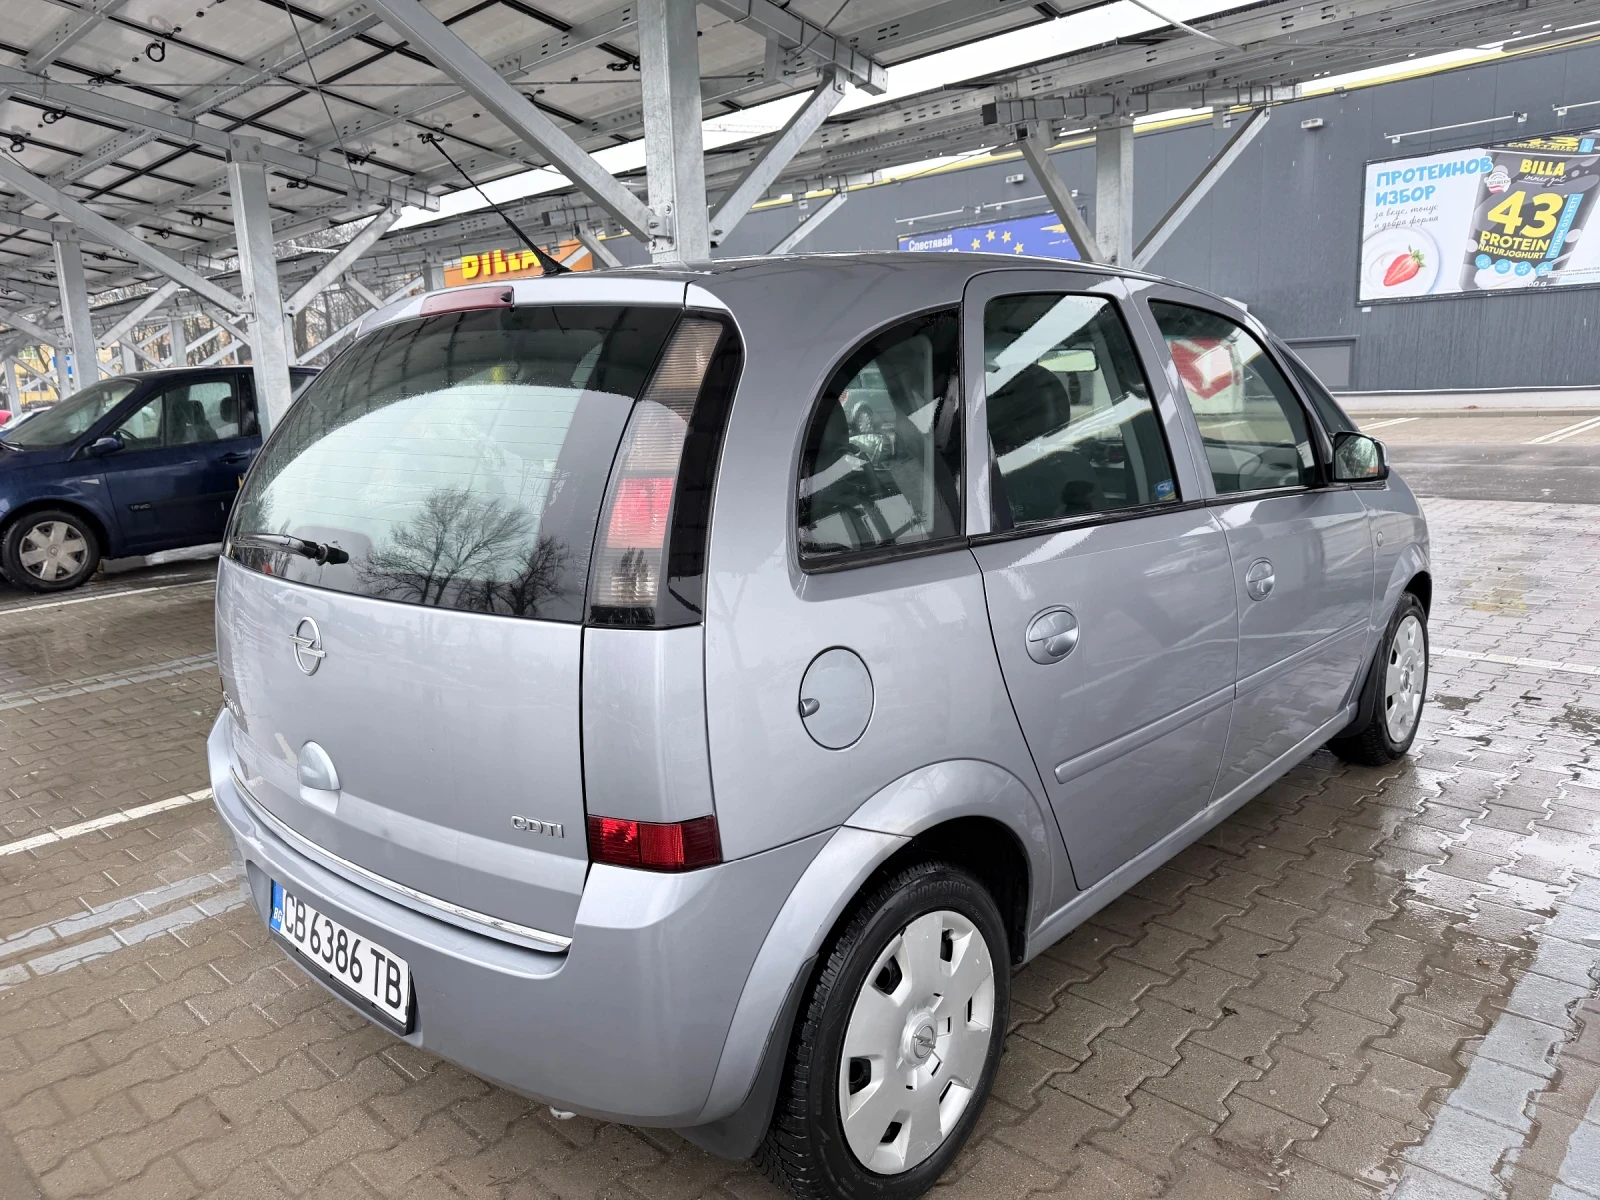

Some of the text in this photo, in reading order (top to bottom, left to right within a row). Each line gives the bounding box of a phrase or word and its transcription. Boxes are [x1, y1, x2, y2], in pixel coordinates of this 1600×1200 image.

[1376, 157, 1493, 187] ПРОТЕИНОВ
[1520, 159, 1565, 176] BILLA
[1375, 185, 1436, 206] ИЗБОР
[1373, 205, 1439, 222] за вкус, тонус
[1382, 219, 1407, 231] добра
[1409, 215, 1439, 228] форма
[909, 234, 953, 251] Спестявай
[1480, 230, 1551, 251] PROTEIN
[1478, 244, 1546, 259] NATURJOGHURT
[511, 815, 564, 838] CDTI
[273, 907, 283, 922] BG
[284, 892, 402, 1009] CB 6386 TB
